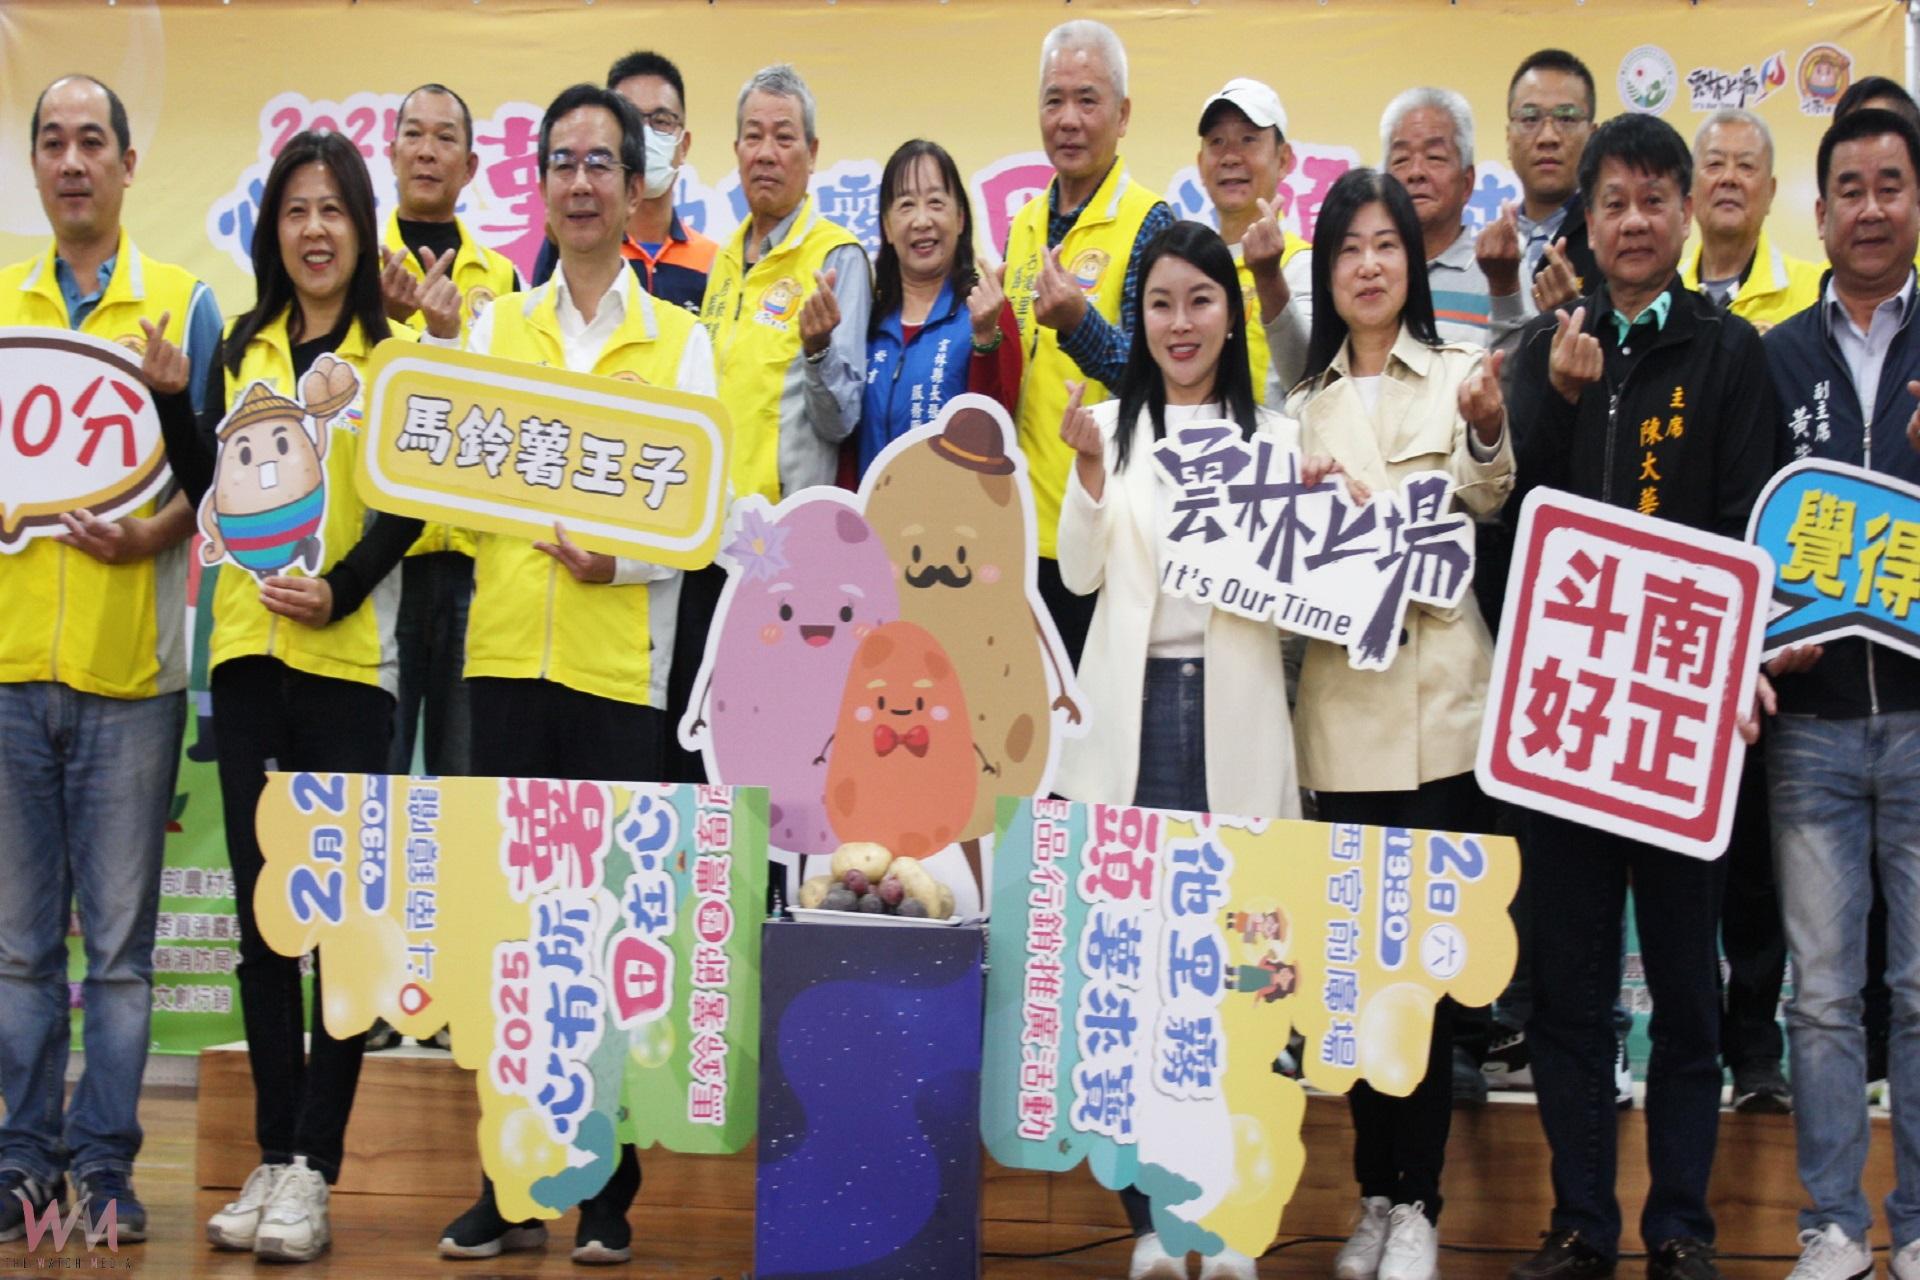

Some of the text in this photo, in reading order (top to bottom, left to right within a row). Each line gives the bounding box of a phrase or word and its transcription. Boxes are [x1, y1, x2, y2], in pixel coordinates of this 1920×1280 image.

[0, 375, 145, 467] 0分
[395, 393, 688, 511] 馬鈴薯王子
[1637, 415, 1664, 516] 陳大華
[1664, 385, 1686, 439] 主席
[1812, 379, 1832, 443] 副主席
[1152, 426, 1471, 665] 雲林上場
[1161, 559, 1353, 637] It's Our Time
[1779, 489, 1920, 620] 覺得
[1543, 548, 1728, 691] 斗南
[1521, 654, 1708, 804] 好正
[290, 772, 345, 923] 2月2
[405, 775, 439, 980] 斗南鎮隴
[1384, 833, 1413, 942] 13:30
[497, 950, 533, 1085] 2025
[506, 779, 605, 1134] 心有所薯
[1161, 841, 1225, 1088] 他里霧
